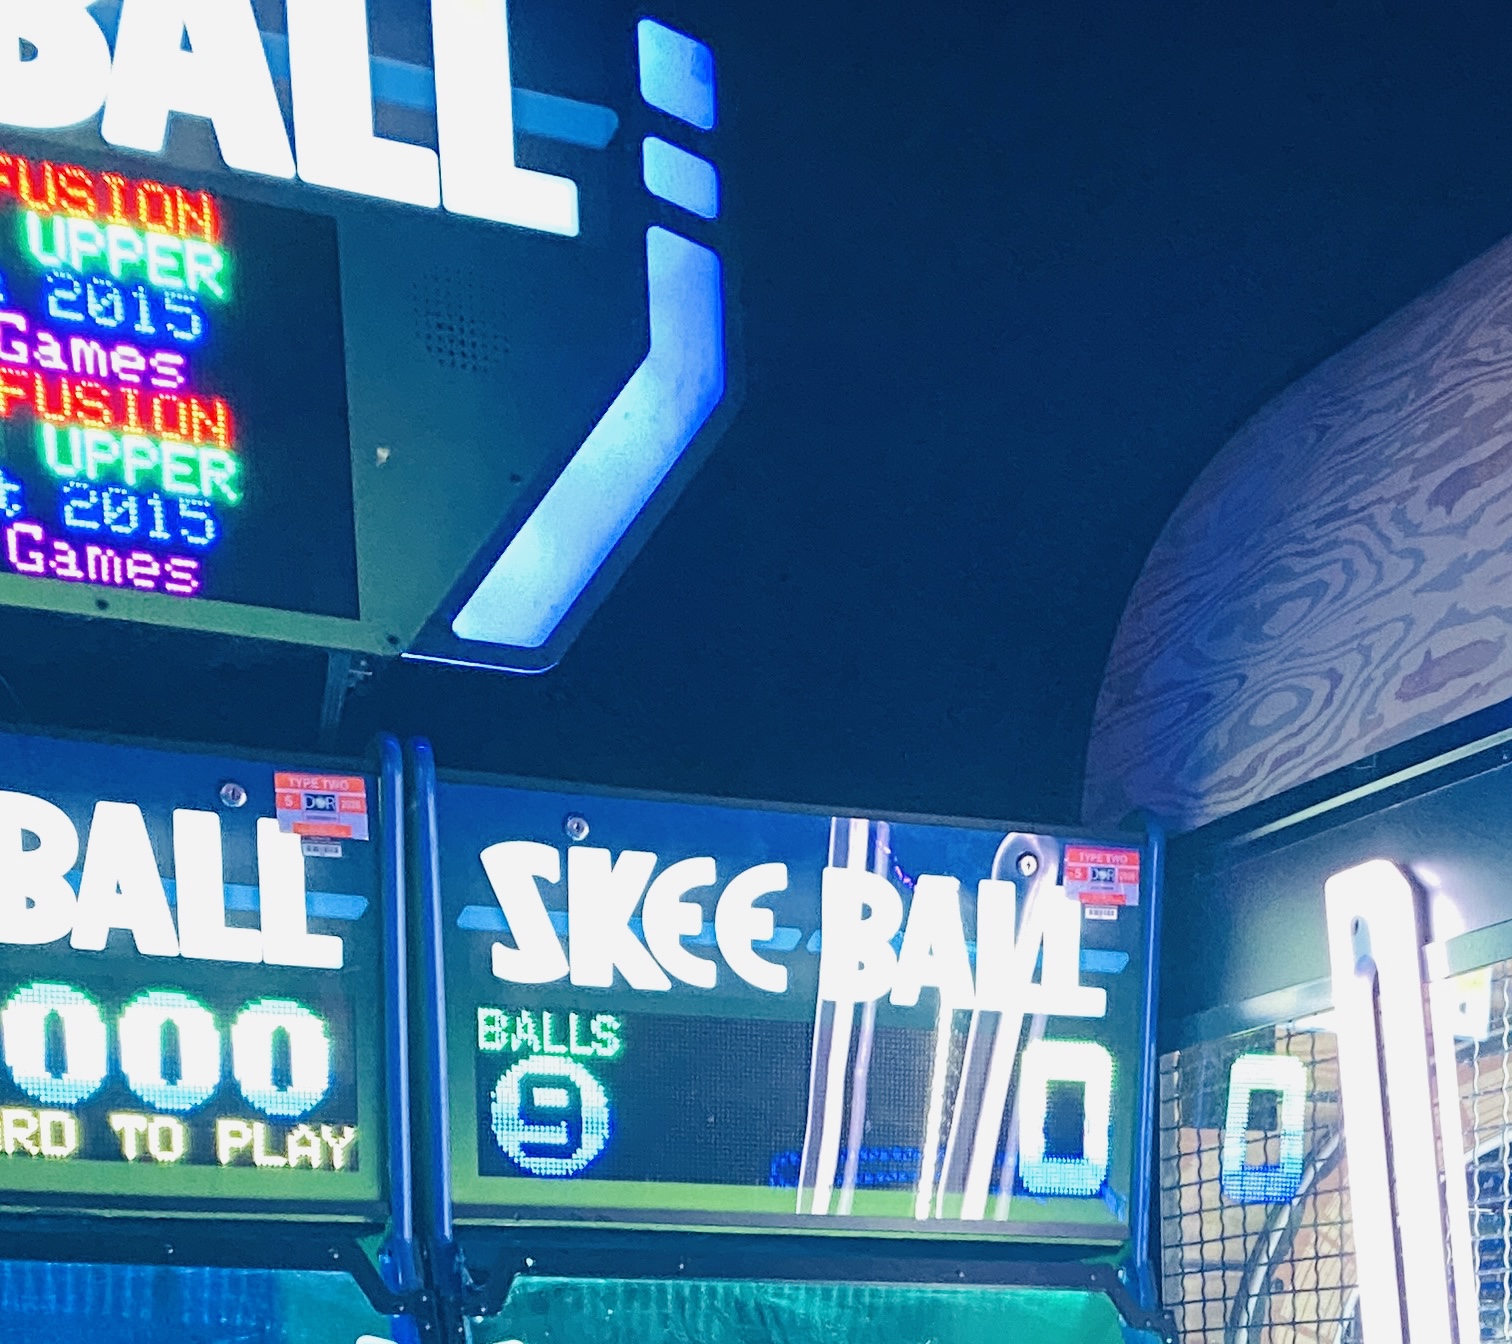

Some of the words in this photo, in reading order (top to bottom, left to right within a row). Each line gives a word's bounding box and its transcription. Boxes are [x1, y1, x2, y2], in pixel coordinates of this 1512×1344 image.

[26, 210, 225, 299] UPPER
[47, 270, 202, 341] 2015
[0, 312, 186, 389] Games
[0, 366, 230, 448] FUSION
[42, 422, 238, 501] UPPER
[63, 481, 216, 546] 2015
[6, 522, 200, 594] Games
[480, 841, 788, 993] SKEE
[820, 866, 1107, 1018] BALL
[477, 1006, 622, 1057] BALLS
[0, 1108, 76, 1159] RD
[108, 1112, 185, 1163] TO
[215, 1116, 358, 1171] PLAY
[1018, 1040, 1112, 1196] 0
